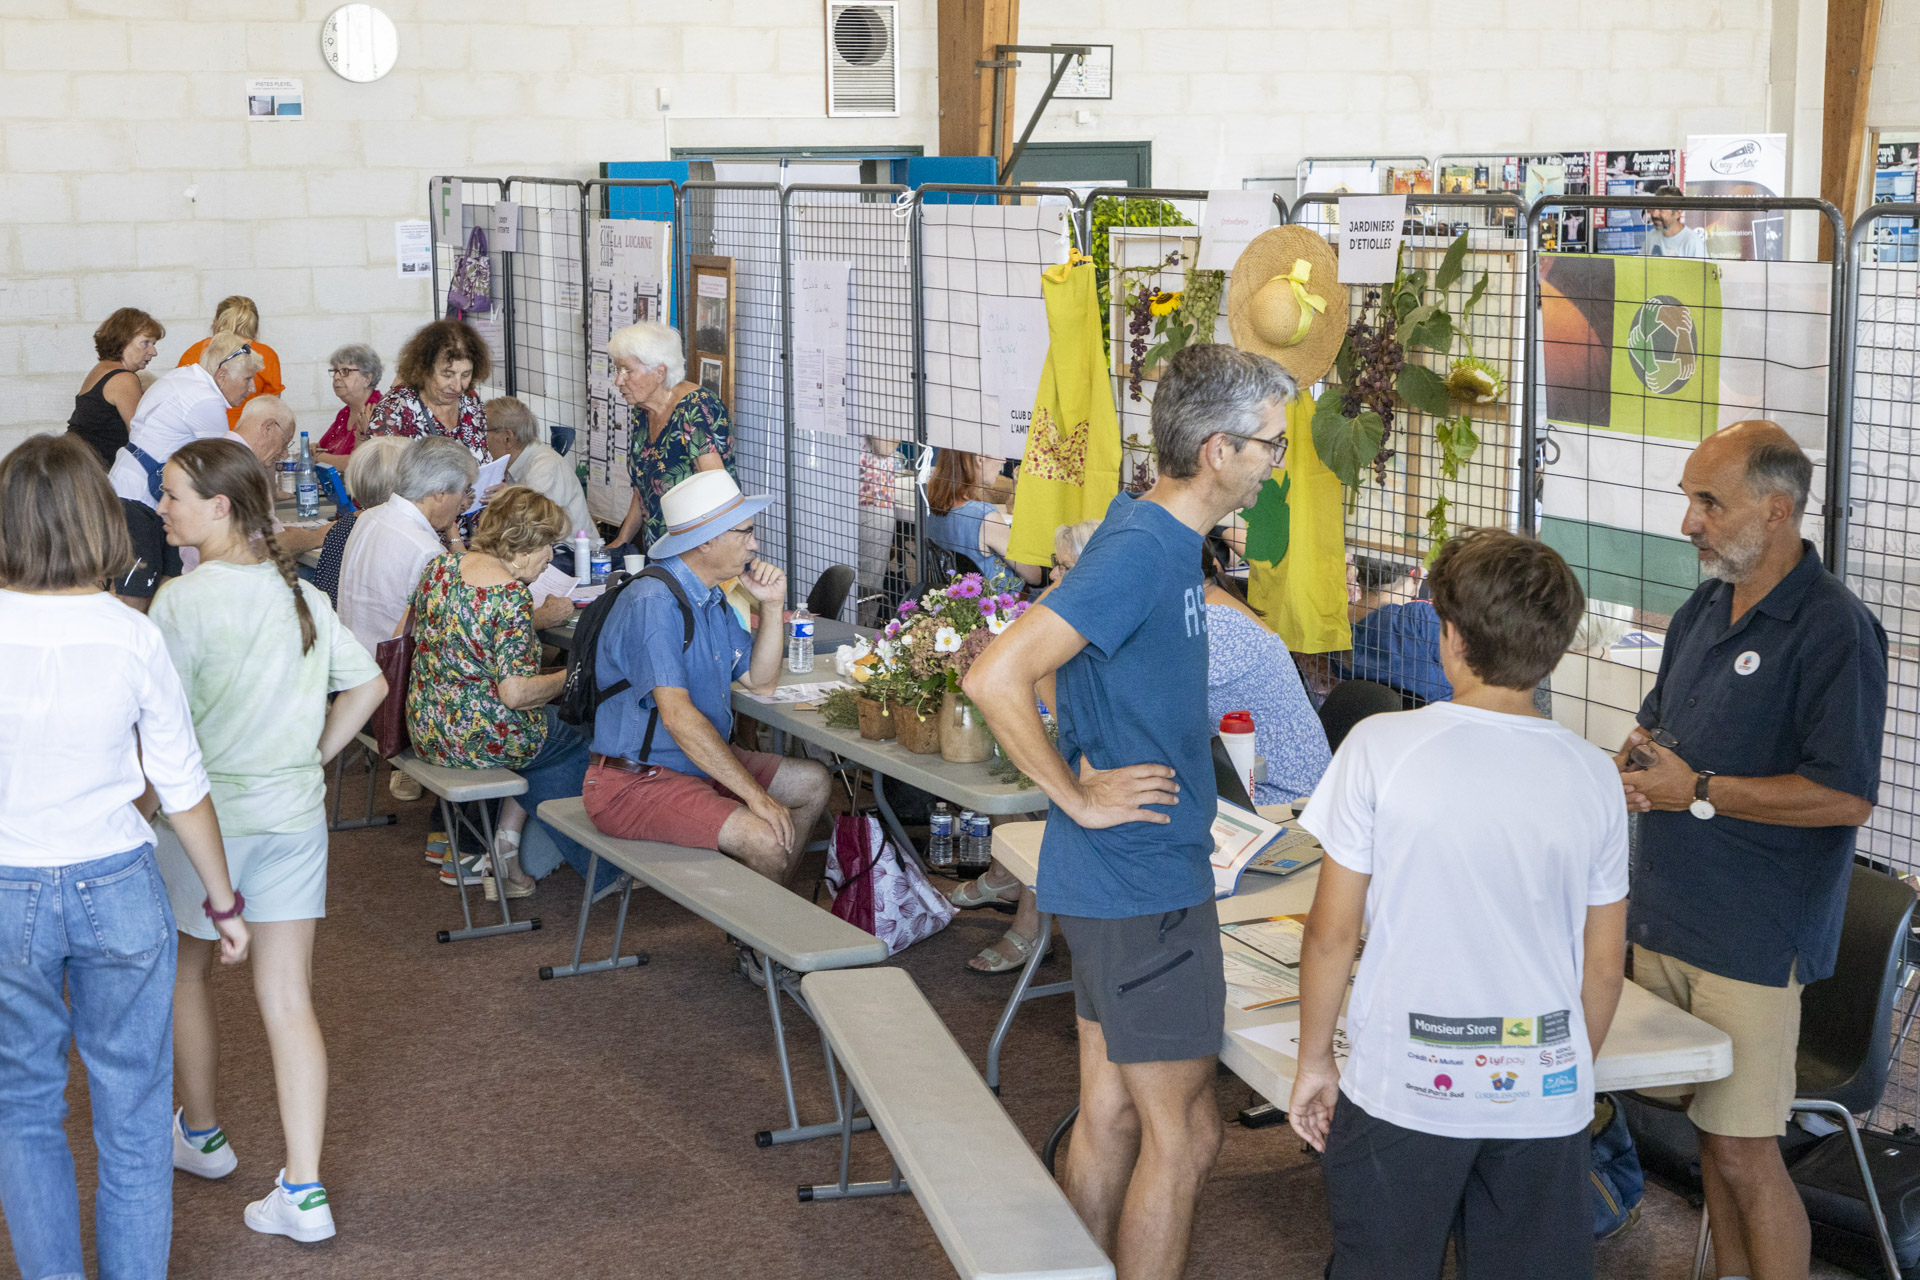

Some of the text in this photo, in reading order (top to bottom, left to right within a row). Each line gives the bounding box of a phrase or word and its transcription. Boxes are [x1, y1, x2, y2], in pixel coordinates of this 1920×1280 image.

[1632, 152, 1670, 164] Apprendre
[1349, 220, 1395, 234] JARDINIERS
[613, 234, 622, 248] LA
[625, 235, 653, 249] LUCARNE
[1349, 238, 1392, 250] D'ETIOLLES
[1011, 409, 1033, 420] CLUB D
[1011, 424, 1030, 434] L'AMIT
[1414, 1018, 1497, 1036] Monsieur Store
[1407, 1051, 1464, 1066] Crédit Mutuel
[1506, 1056, 1526, 1068] pay
[1405, 1082, 1427, 1094] Grand
[1428, 1089, 1448, 1098] Paris
